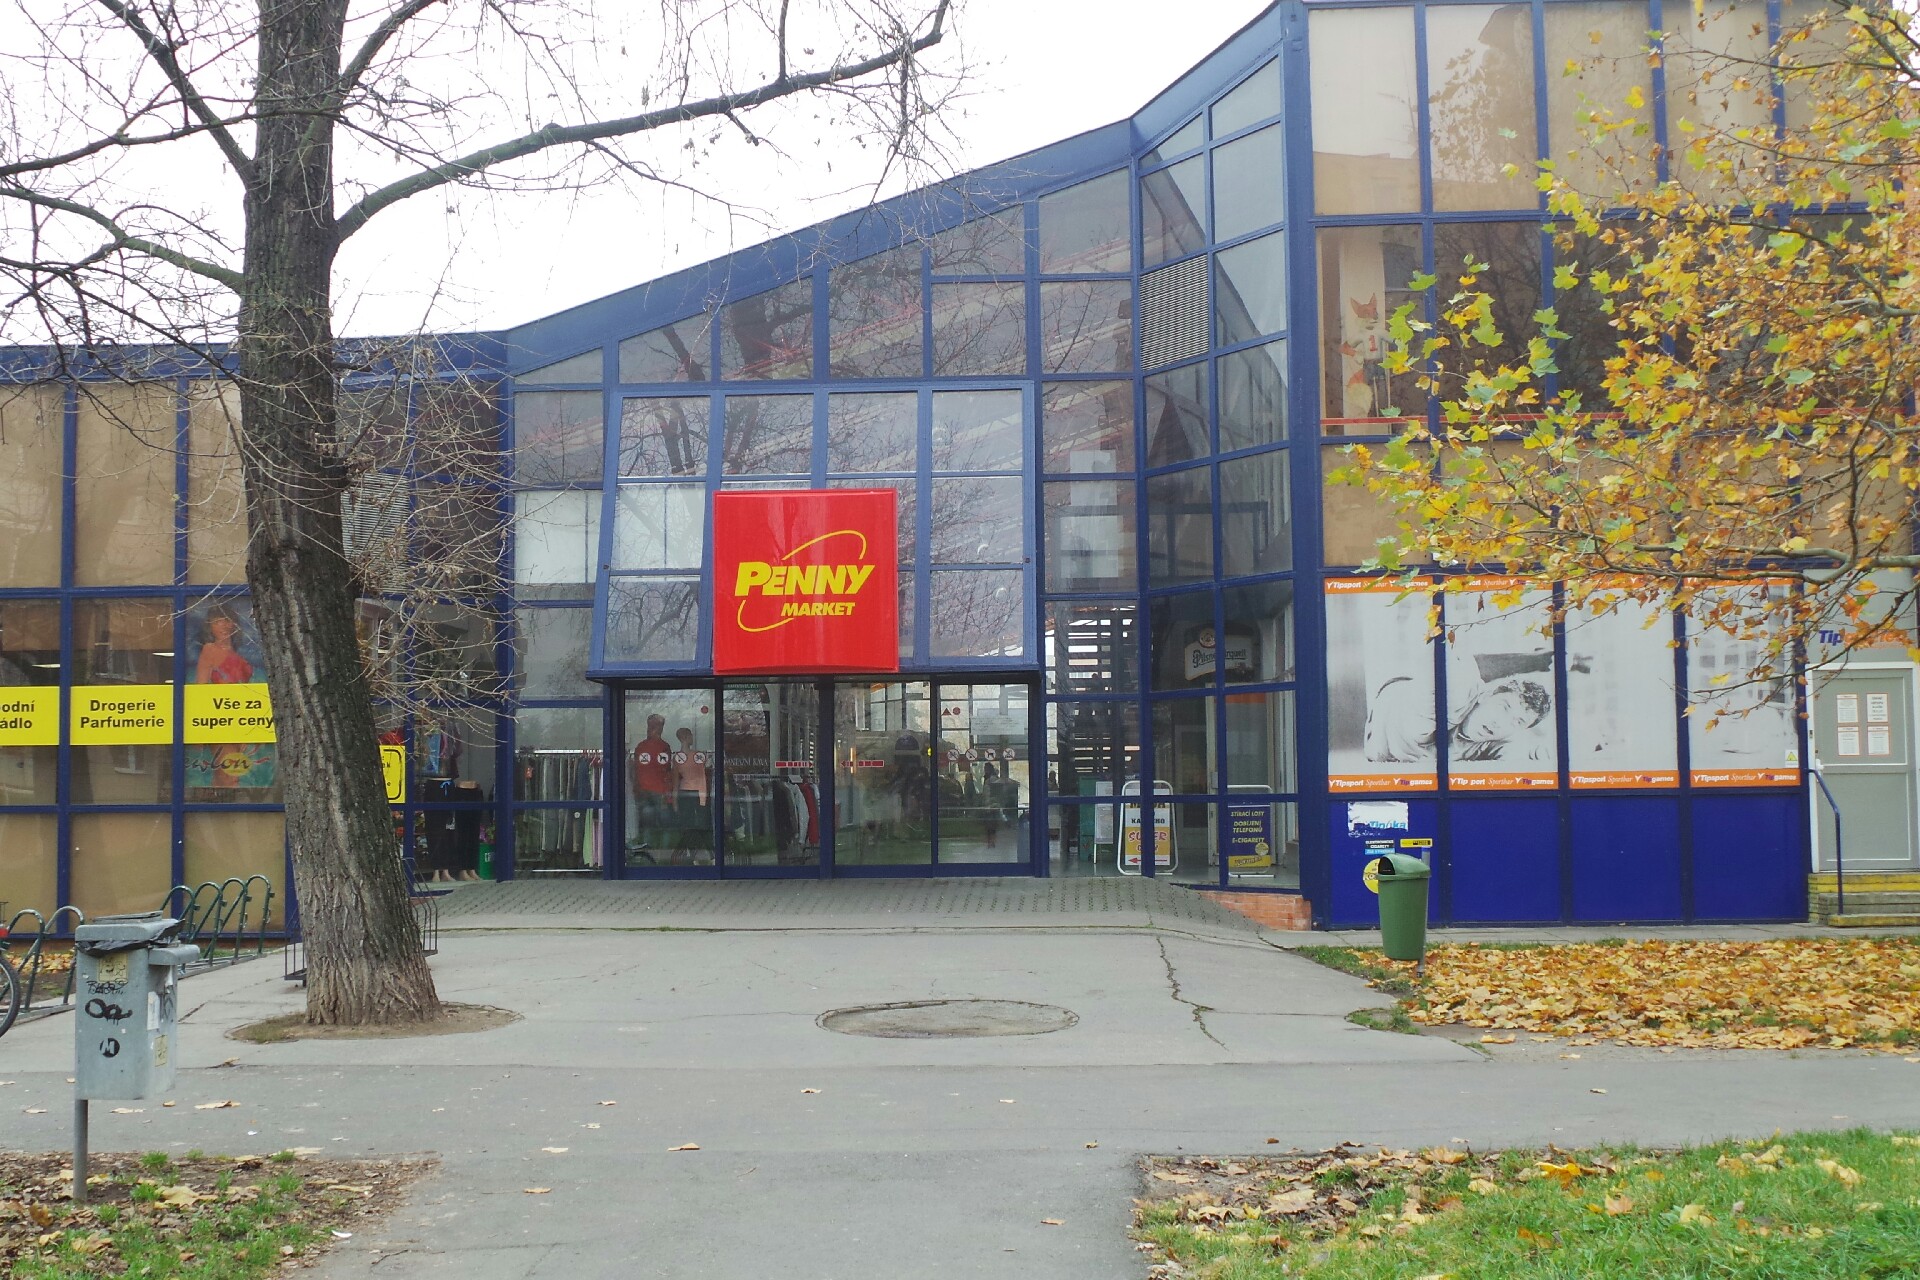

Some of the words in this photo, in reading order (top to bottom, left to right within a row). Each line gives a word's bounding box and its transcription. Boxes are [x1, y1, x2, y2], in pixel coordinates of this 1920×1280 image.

[734, 561, 875, 597] PENNY
[1333, 581, 1362, 590] Tipsport
[780, 602, 856, 617] MARKET
[0, 699, 35, 713] odní
[90, 698, 156, 716] Drogerie
[213, 697, 240, 710] Vše
[245, 699, 262, 710] za
[80, 715, 165, 729] Parfumerie
[192, 717, 233, 729] super
[238, 716, 273, 729] ceny
[1335, 779, 1364, 788] Tipsport
[1577, 775, 1606, 784] Tipsport
[1700, 774, 1730, 783] Tipsport
